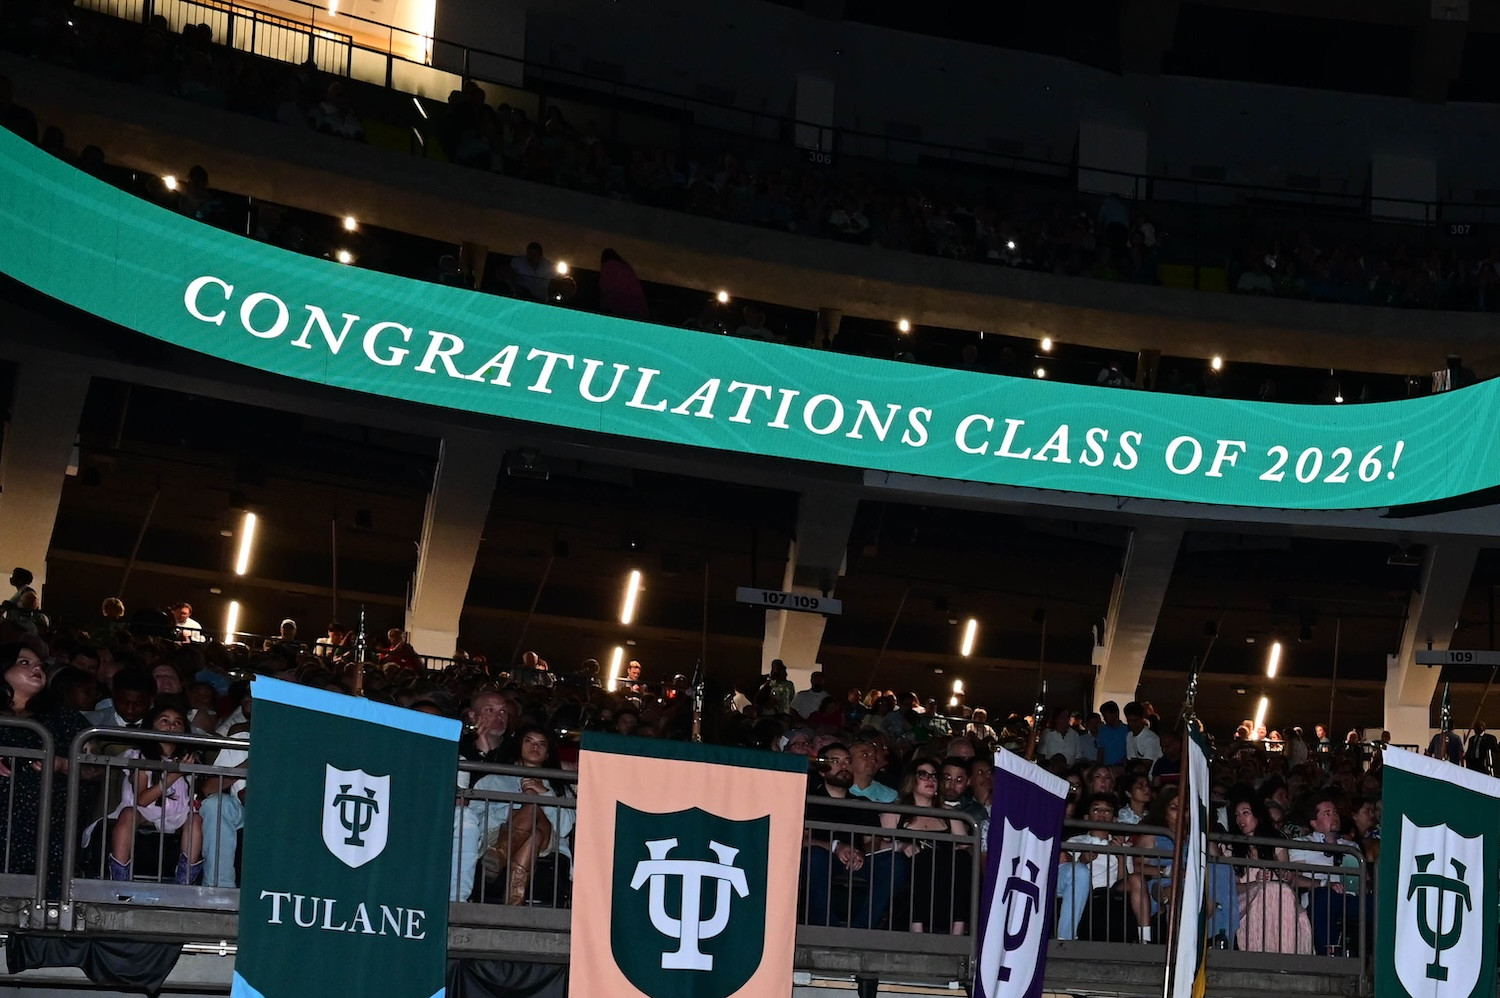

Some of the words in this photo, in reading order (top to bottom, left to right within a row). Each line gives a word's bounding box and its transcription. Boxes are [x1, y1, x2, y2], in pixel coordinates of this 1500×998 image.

[809, 151, 832, 165] 306
[1450, 224, 1471, 235] 307
[183, 275, 933, 448] CONGRATULATIONS
[954, 413, 1143, 471] CLASS
[1164, 435, 1247, 478] OF
[1259, 441, 1405, 485] 2026!
[762, 592, 787, 604] 107
[794, 597, 818, 608] 109
[1450, 652, 1473, 662] 109
[259, 891, 426, 940] TULANE
